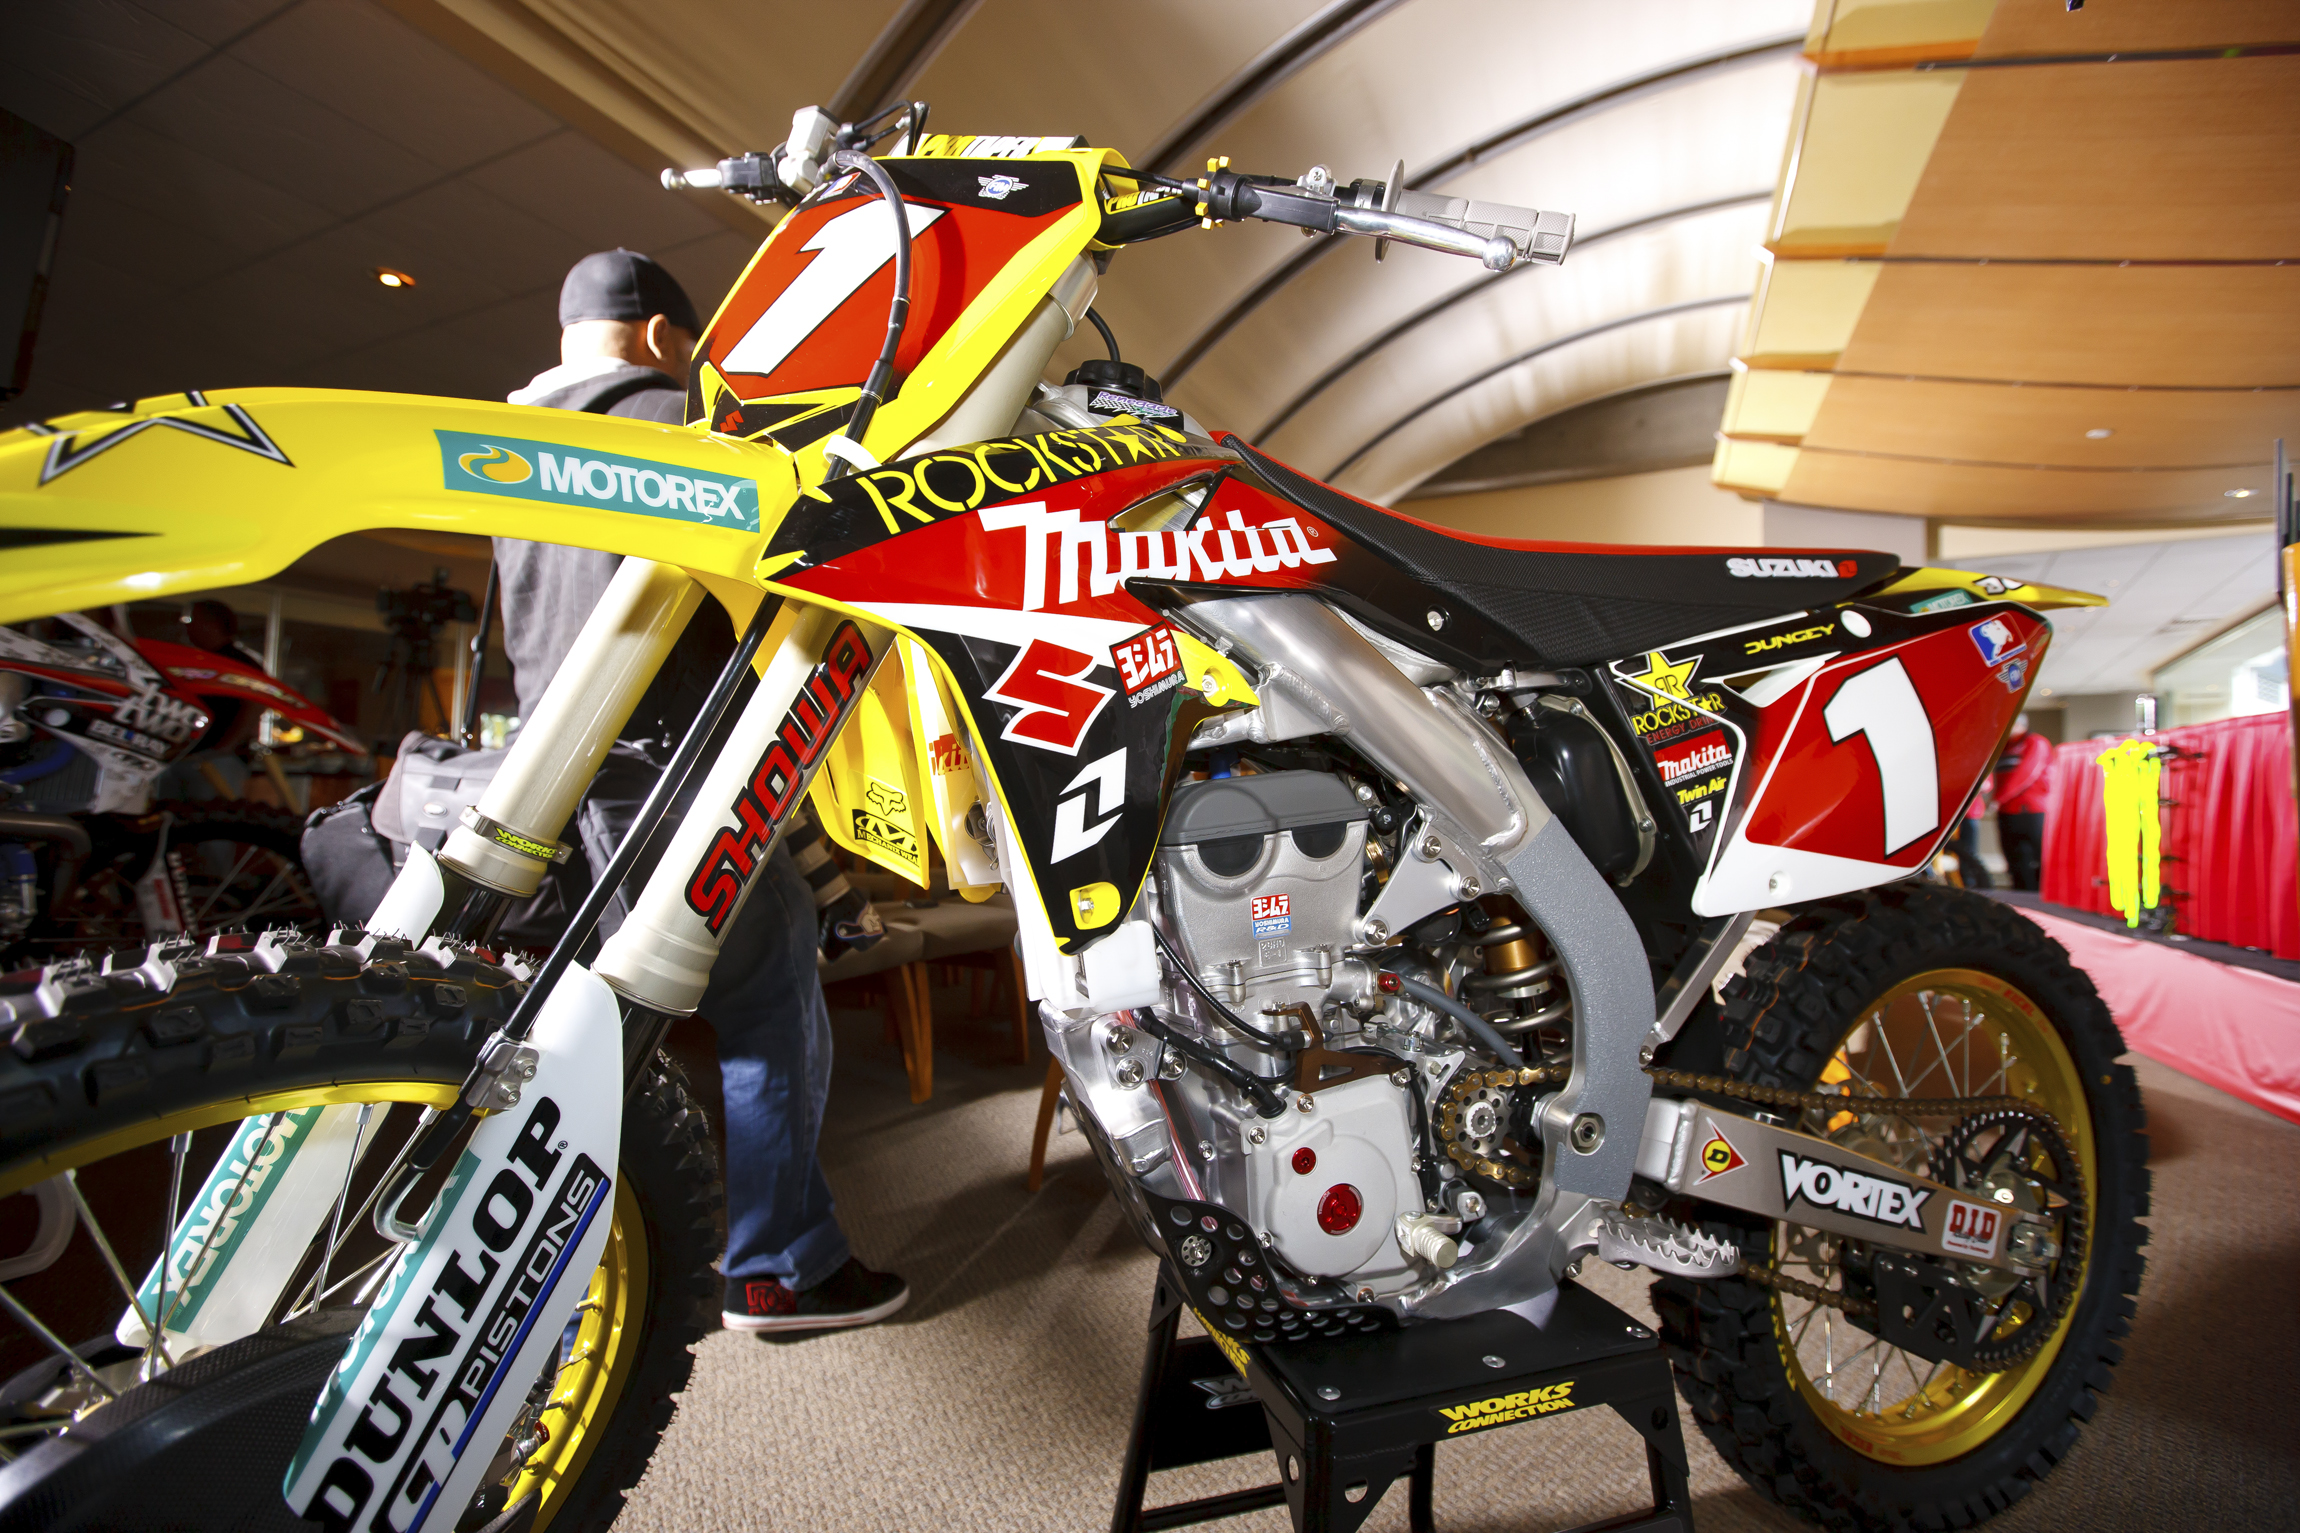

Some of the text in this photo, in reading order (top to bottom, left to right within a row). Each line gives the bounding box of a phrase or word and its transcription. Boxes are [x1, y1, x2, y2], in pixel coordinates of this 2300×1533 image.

[720, 200, 951, 376] 1
[538, 452, 745, 520] MOTOREX
[857, 425, 1186, 534] ROCKSTAR
[1726, 558, 1839, 578] SUZUKI
[1115, 628, 1176, 690] ヨシムラ
[1744, 623, 1835, 655] DUNGEY
[1127, 670, 1186, 709] YOSHIMURA
[1632, 693, 1725, 735] ROCKSTAR
[1646, 712, 1721, 744] ENERGY DRIN
[1657, 744, 1733, 781] Makita
[1664, 758, 1734, 788] INDUSTRIAL POWER TOOLS
[1823, 656, 1940, 858] 1
[687, 622, 873, 934] SHOWA
[1676, 776, 1727, 805] Twin Air
[1253, 894, 1289, 919] ヨシムラ
[1255, 923, 1290, 933] R&D
[1782, 1154, 1931, 1229] VORTEX
[460, 1169, 595, 1400] PISTONS
[303, 1096, 563, 1533] DUNLOP
[1438, 1381, 1575, 1421] WORKS
[1447, 1397, 1576, 1434] CONNECTION
